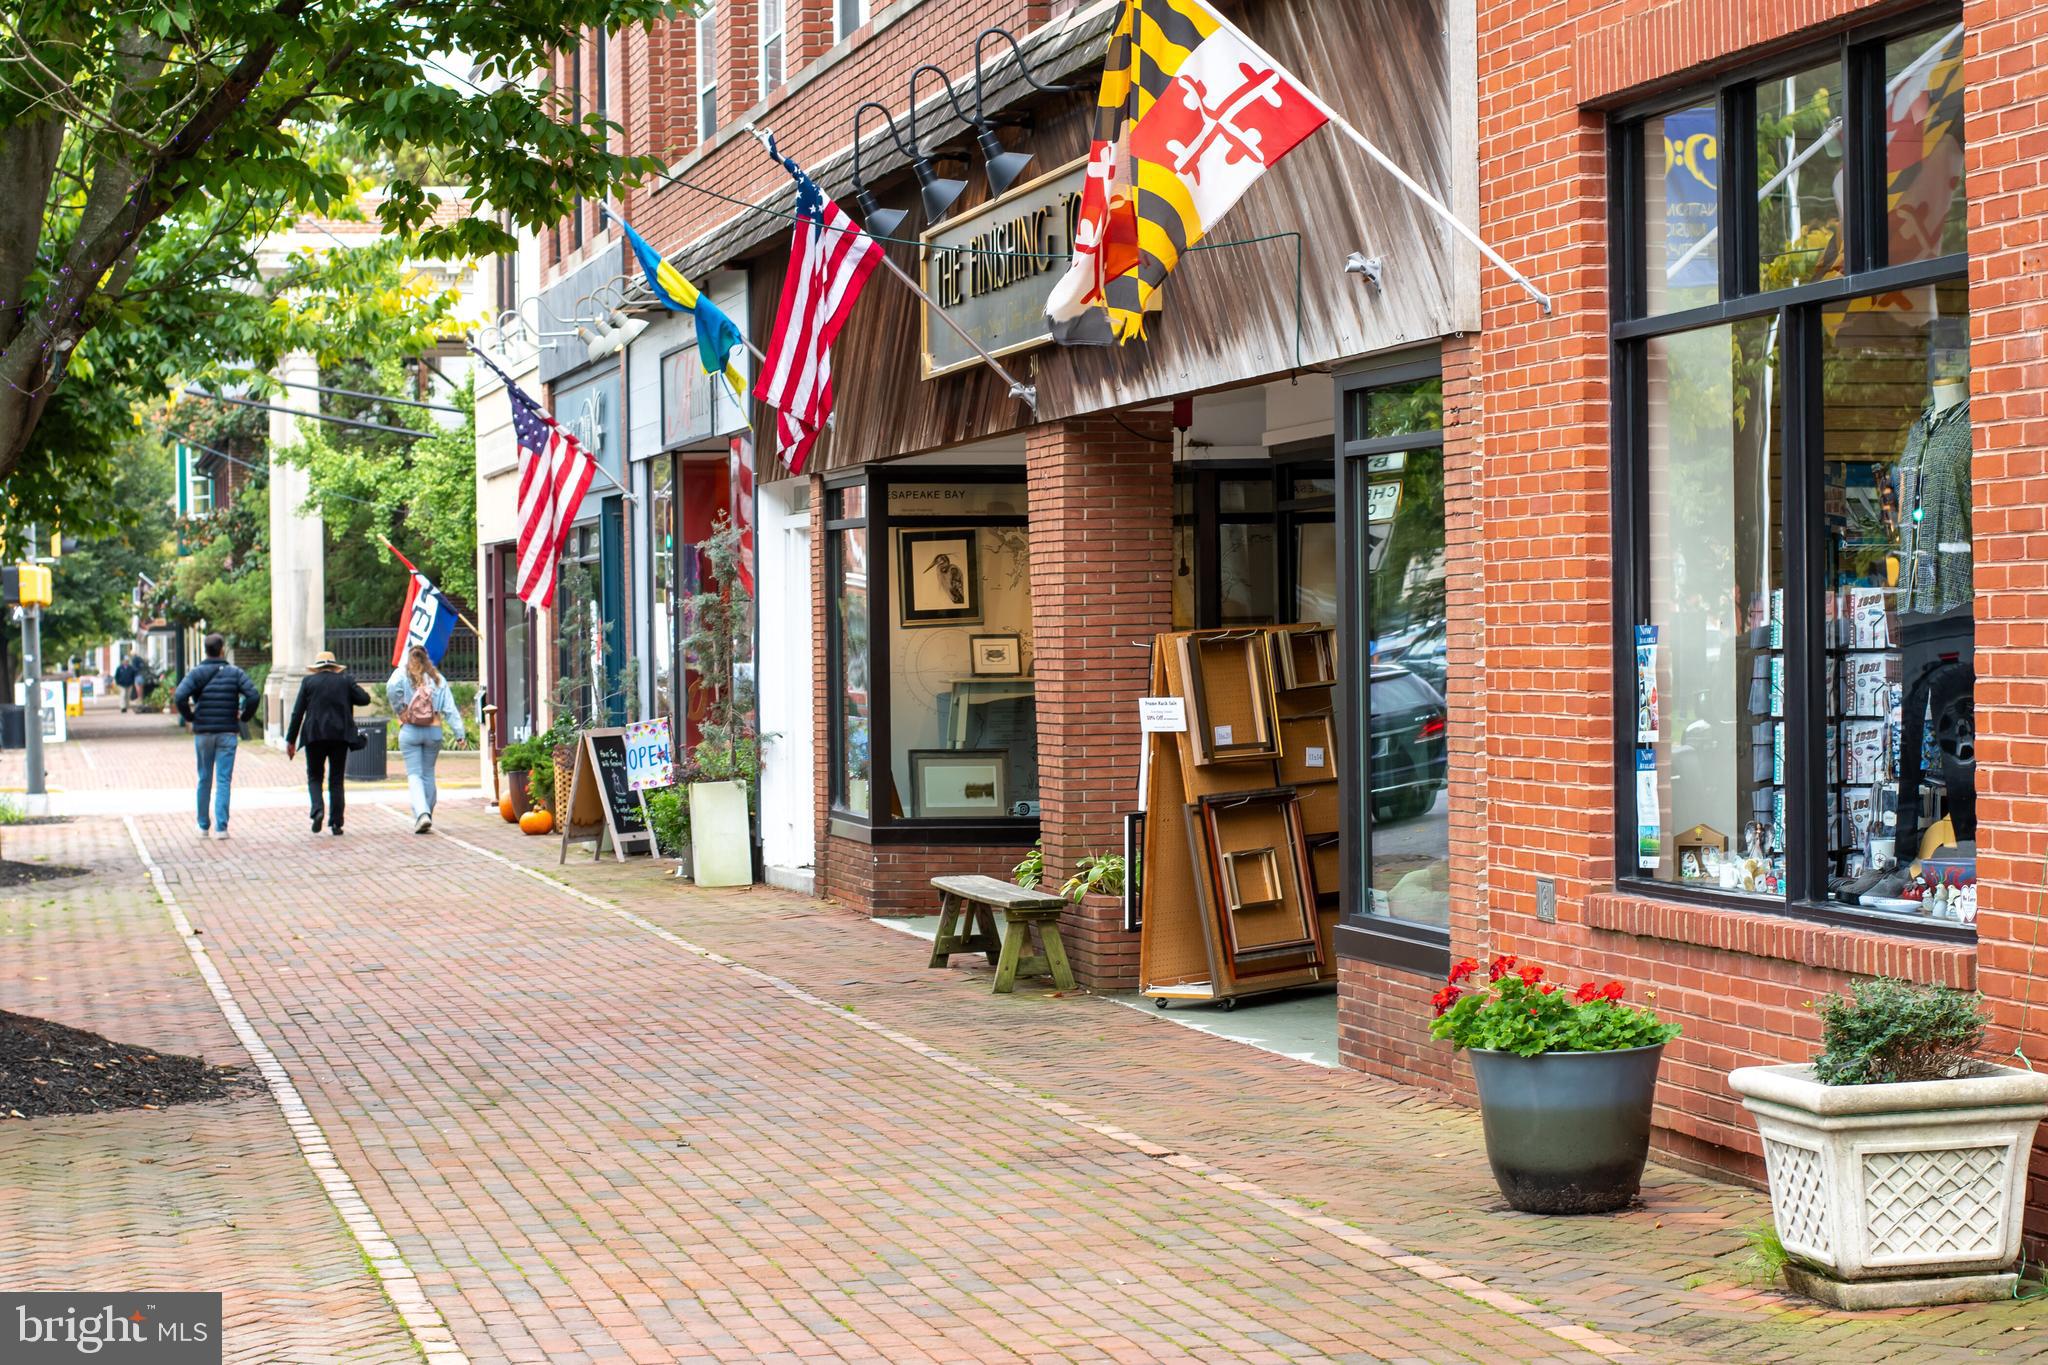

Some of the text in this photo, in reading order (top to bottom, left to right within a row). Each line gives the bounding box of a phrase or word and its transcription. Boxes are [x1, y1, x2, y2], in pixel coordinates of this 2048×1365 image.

[935, 245, 963, 309] THE
[969, 206, 1052, 298] FINISHING
[944, 490, 966, 500] BAY
[628, 743, 671, 770] OPEN
